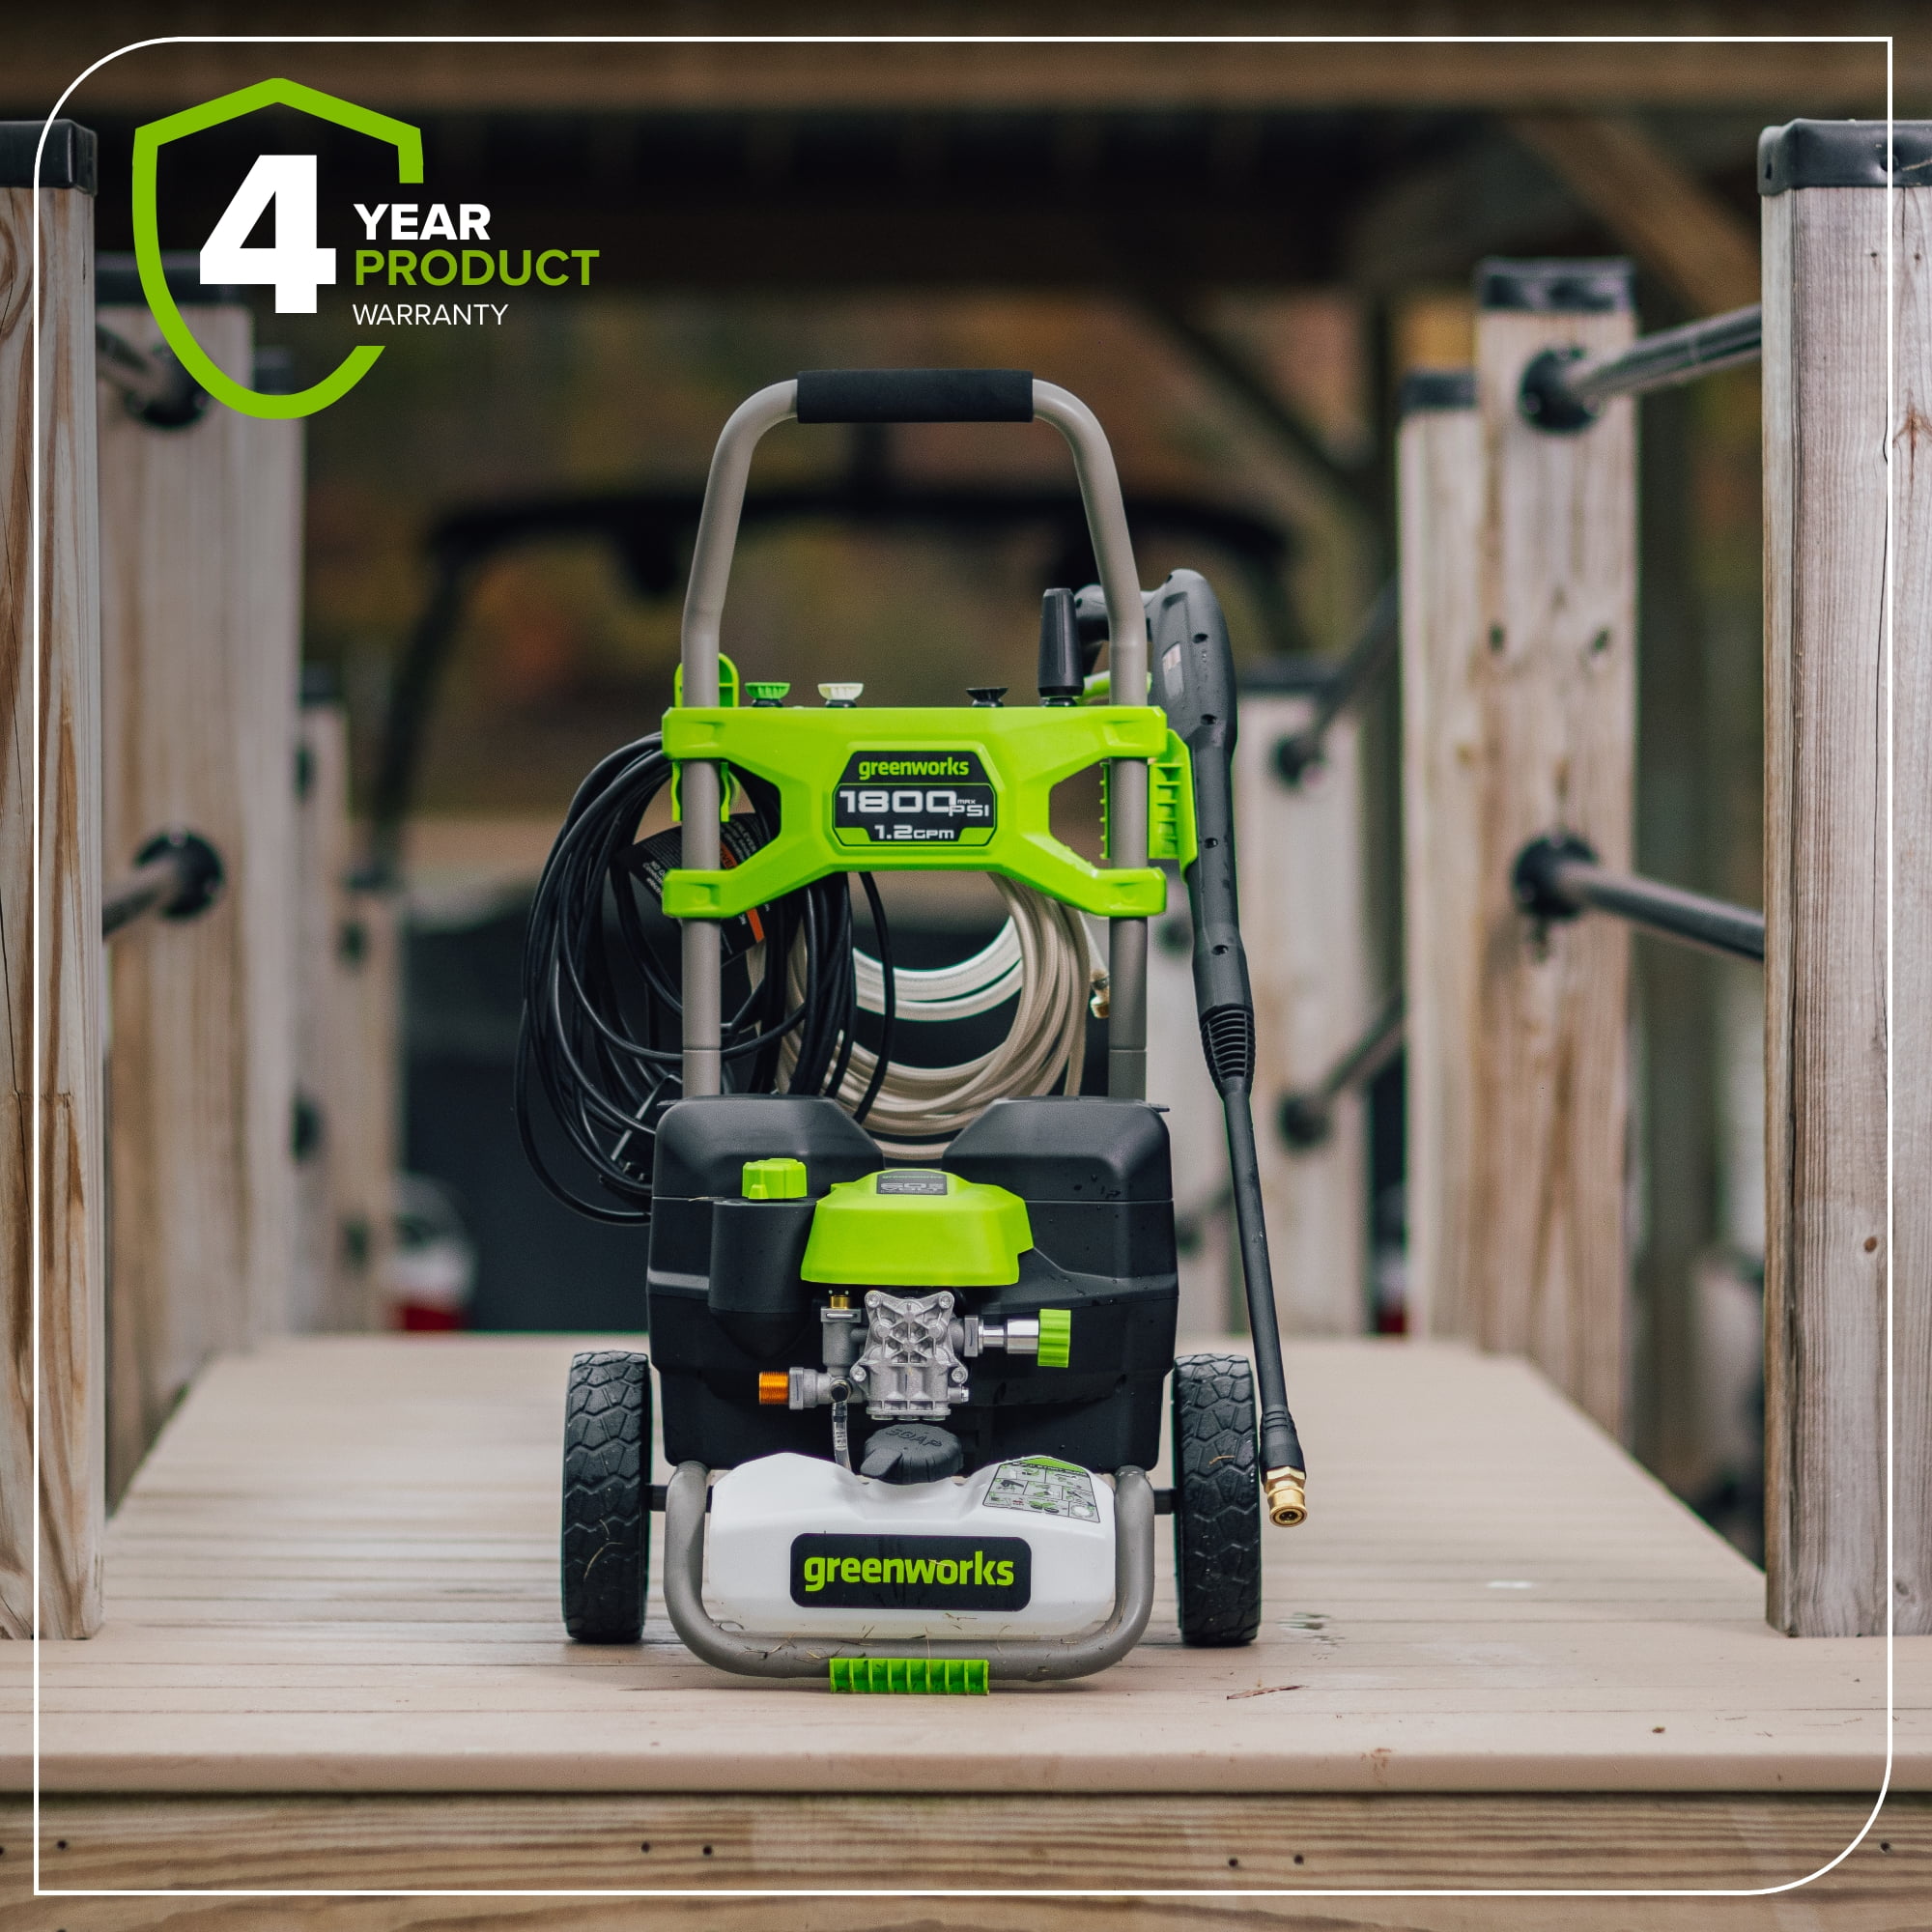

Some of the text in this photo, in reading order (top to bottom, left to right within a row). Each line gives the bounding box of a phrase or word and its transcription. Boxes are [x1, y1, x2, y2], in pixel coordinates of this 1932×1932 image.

[858, 756, 970, 781] greenworks
[839, 790, 957, 813] 1800
[948, 804, 990, 817] PSI
[885, 1429, 943, 1447] SOAP
[804, 1549, 1015, 1593] greenworks
